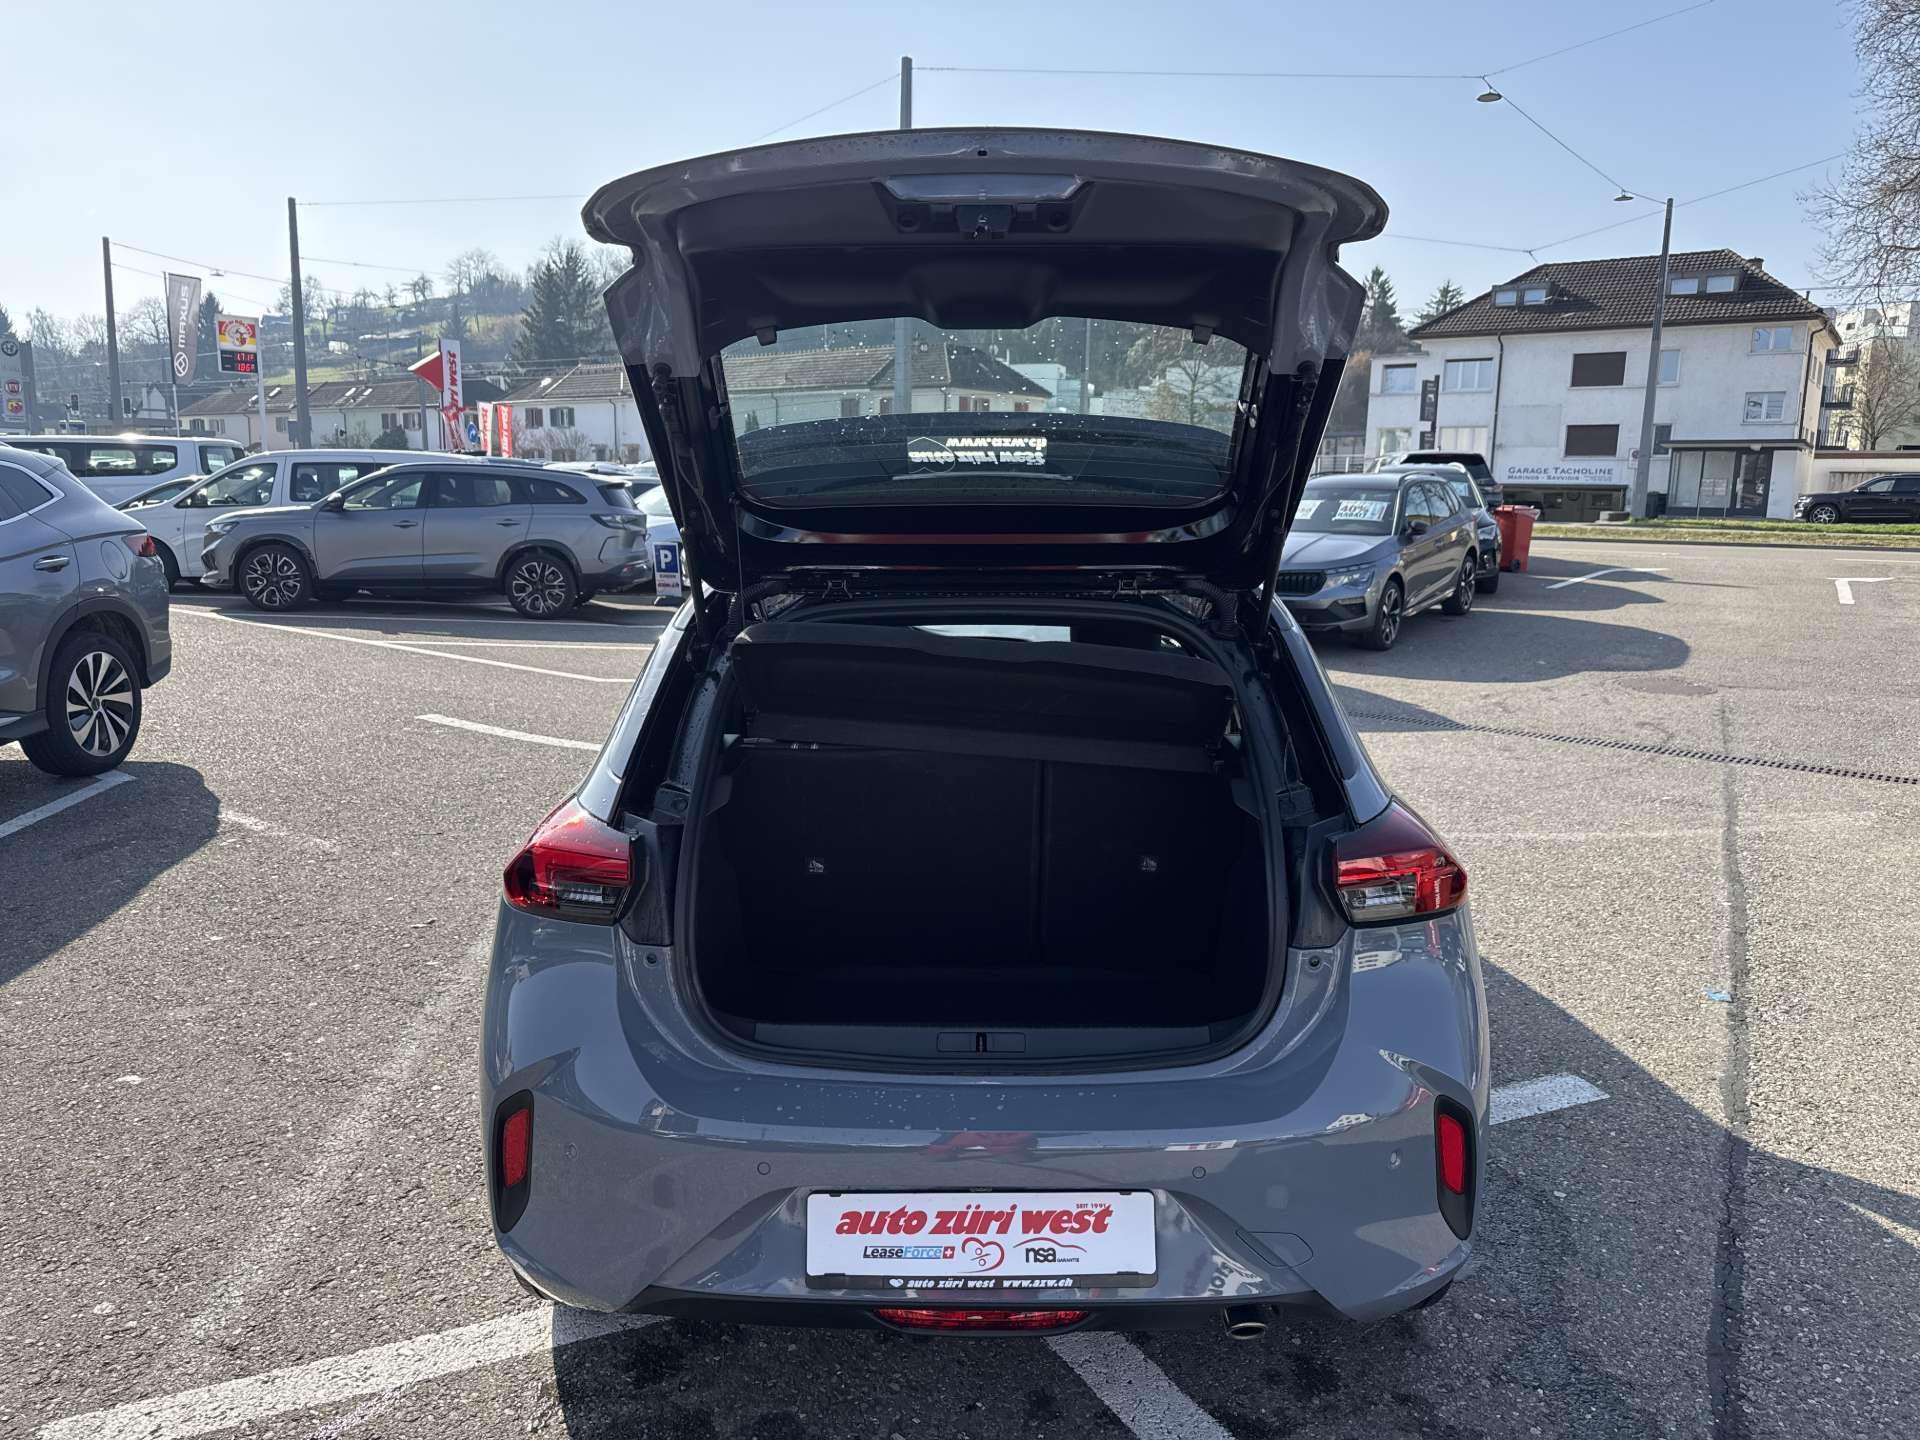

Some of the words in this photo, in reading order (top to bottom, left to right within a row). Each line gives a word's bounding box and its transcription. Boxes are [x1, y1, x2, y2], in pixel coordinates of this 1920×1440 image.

[178, 285, 190, 348] MAXUS
[1508, 466, 1549, 475] GARAGE
[1553, 466, 1614, 475] TACHOLINE
[659, 549, 672, 569] P
[835, 1204, 928, 1235] auto
[927, 1204, 1017, 1235] züri
[1021, 1204, 1114, 1234] west
[863, 1245, 943, 1259] LeaseForce
[1025, 1247, 1057, 1263] nsa
[907, 1279, 934, 1288] auto
[937, 1278, 964, 1288] züri
[967, 1279, 996, 1288] west
[1002, 1277, 1074, 1288] www.azw.ch
